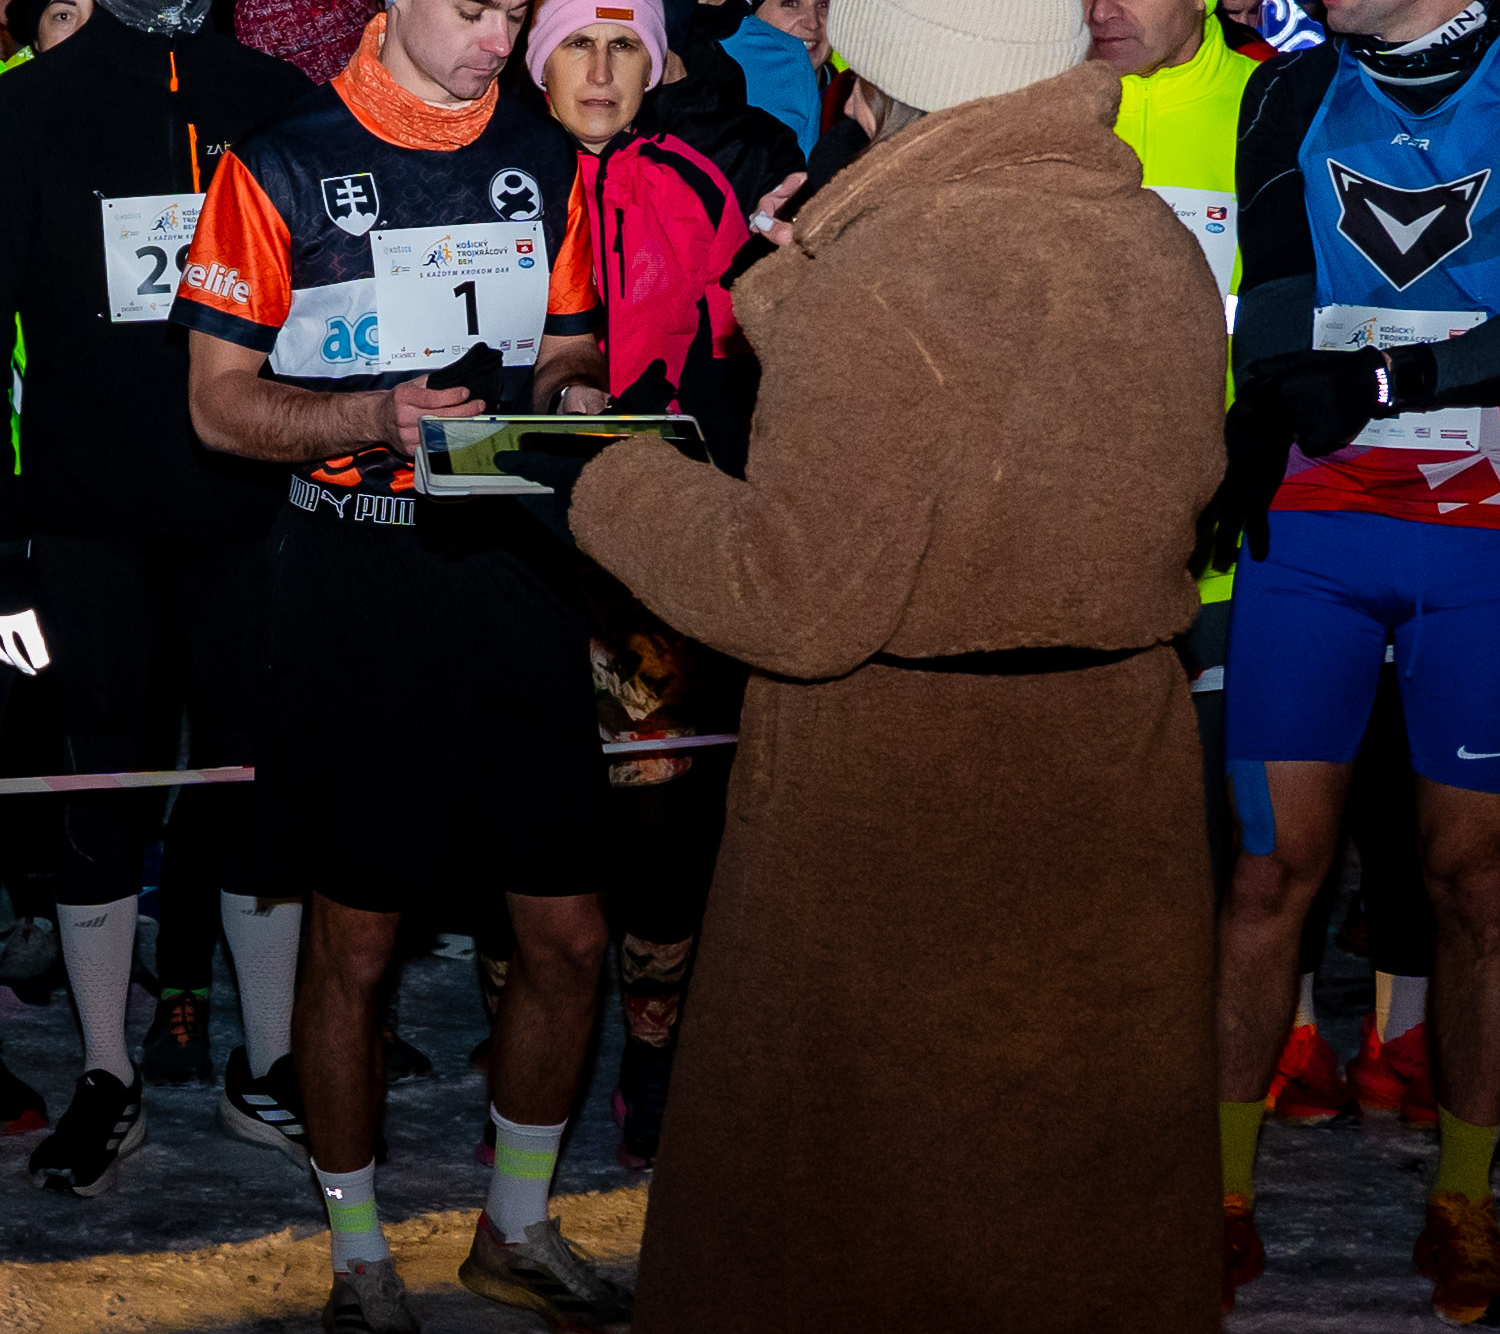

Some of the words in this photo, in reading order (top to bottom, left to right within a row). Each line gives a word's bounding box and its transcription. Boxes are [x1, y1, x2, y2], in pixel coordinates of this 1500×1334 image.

[456, 239, 488, 248] KOŠICKÝ
[453, 281, 479, 335] 1
[355, 493, 416, 525] PUM
